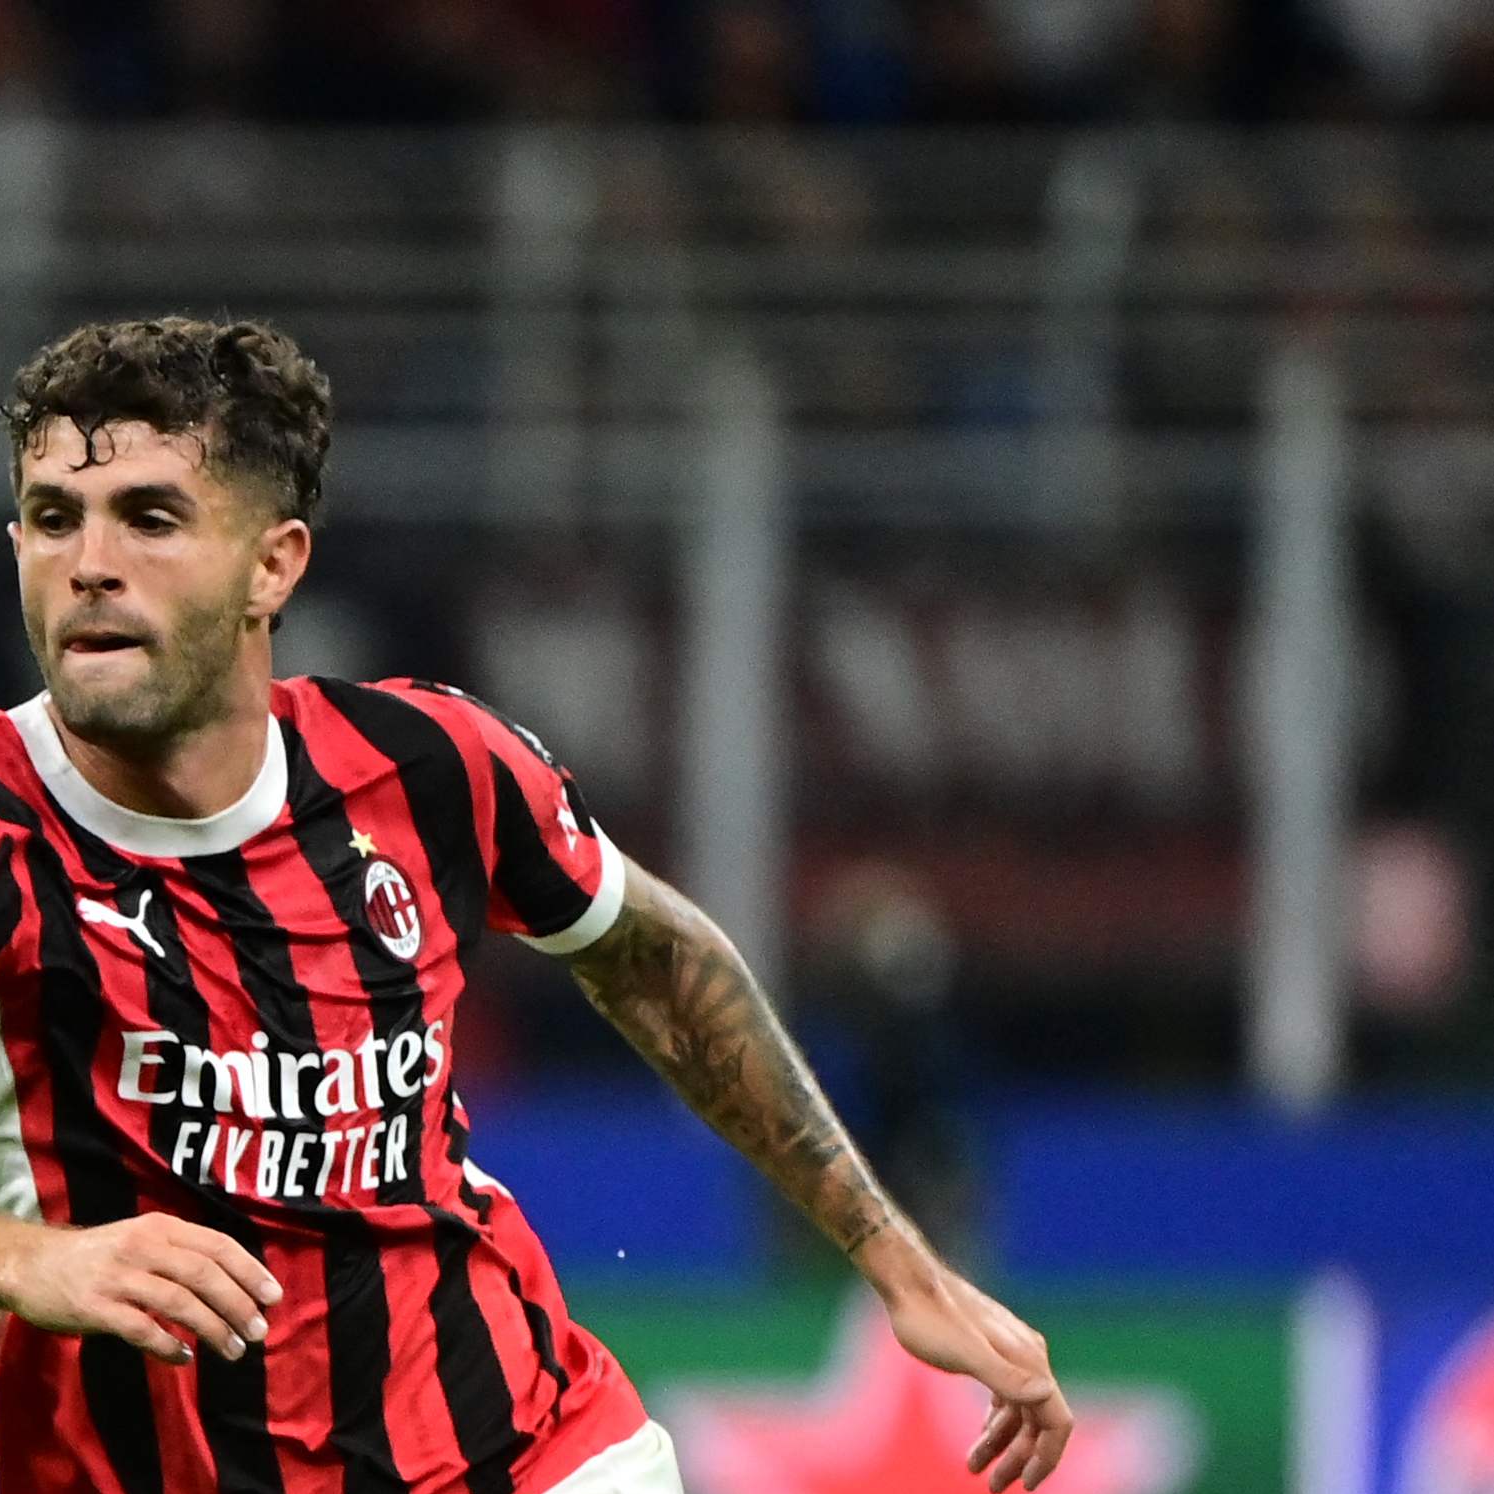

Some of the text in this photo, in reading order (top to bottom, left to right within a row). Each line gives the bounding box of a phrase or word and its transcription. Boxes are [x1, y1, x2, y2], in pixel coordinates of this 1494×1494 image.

[116, 1019, 445, 1121] Emirates
[171, 1113, 408, 1198] FLY BETTER
